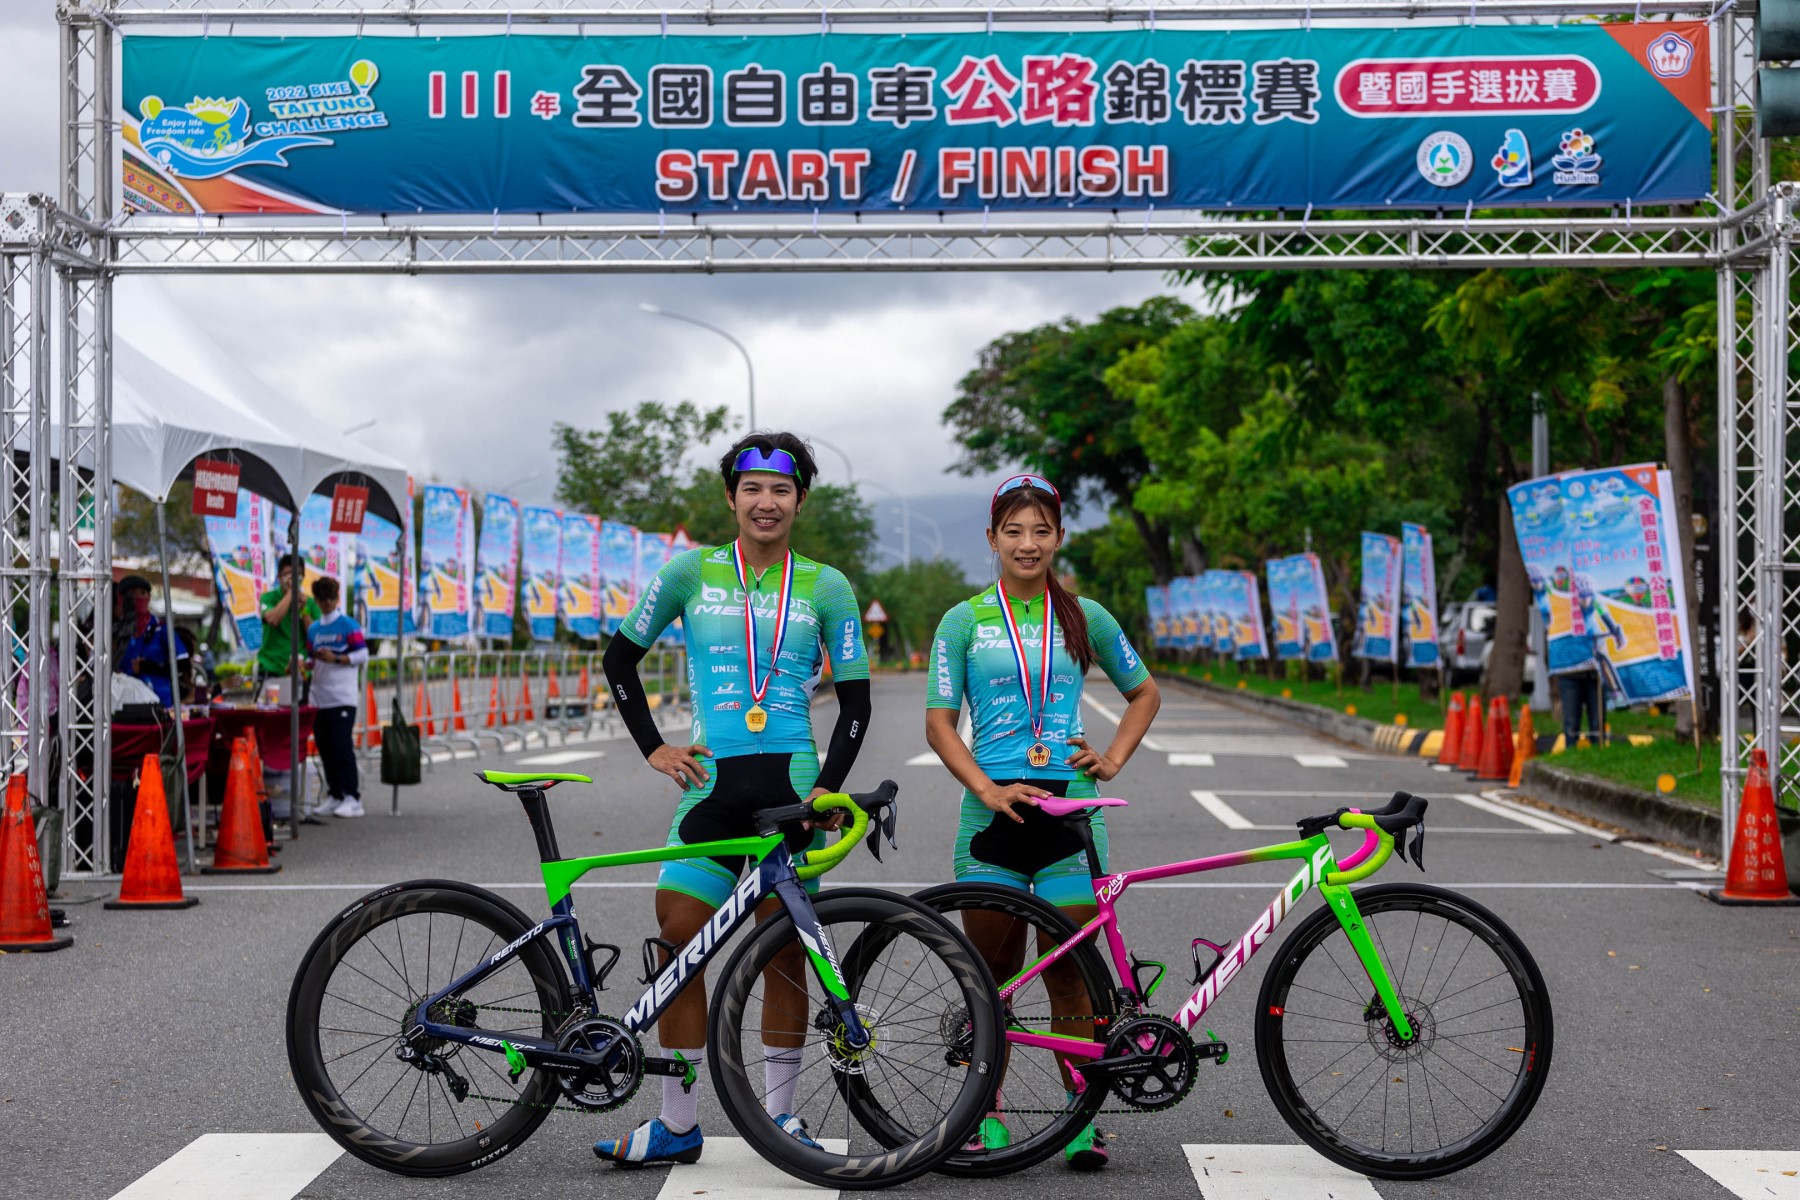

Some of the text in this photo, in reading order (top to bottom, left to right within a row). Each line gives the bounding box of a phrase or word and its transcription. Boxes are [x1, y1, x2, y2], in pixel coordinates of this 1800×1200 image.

[266, 81, 351, 101] 2022 BIKE
[270, 95, 375, 118] TAITUNG
[1358, 68, 1578, 106] 暨國手選拔賽
[147, 128, 205, 136] Freedom ride
[162, 119, 203, 128] Enjoy life
[255, 112, 388, 137] CHALLENGE
[656, 145, 1170, 201] START / FINISH
[1639, 497, 1678, 661] 全國自由車公路錦標賽
[635, 576, 663, 636] MAXXIS
[842, 620, 855, 660] KMC
[1119, 632, 1137, 669] KMC
[711, 665, 739, 674] UNIX
[938, 639, 954, 698] MAXXIS
[1052, 674, 1074, 685] VELO
[991, 694, 1018, 706] UNIX
[1744, 812, 1759, 882] 自由車協會
[1761, 813, 1775, 882] 中華民國
[490, 922, 544, 965] REACTO
[624, 867, 762, 1028] MERIDA
[814, 921, 847, 986] MERIDA
[884, 911, 990, 1004] FAR
[1054, 931, 1086, 958] SCULTURA
[1180, 845, 1336, 1032] MERIDA
[312, 1089, 429, 1163] FAR
[471, 1144, 509, 1168] MAXXIS
[824, 1117, 948, 1178] FAR
